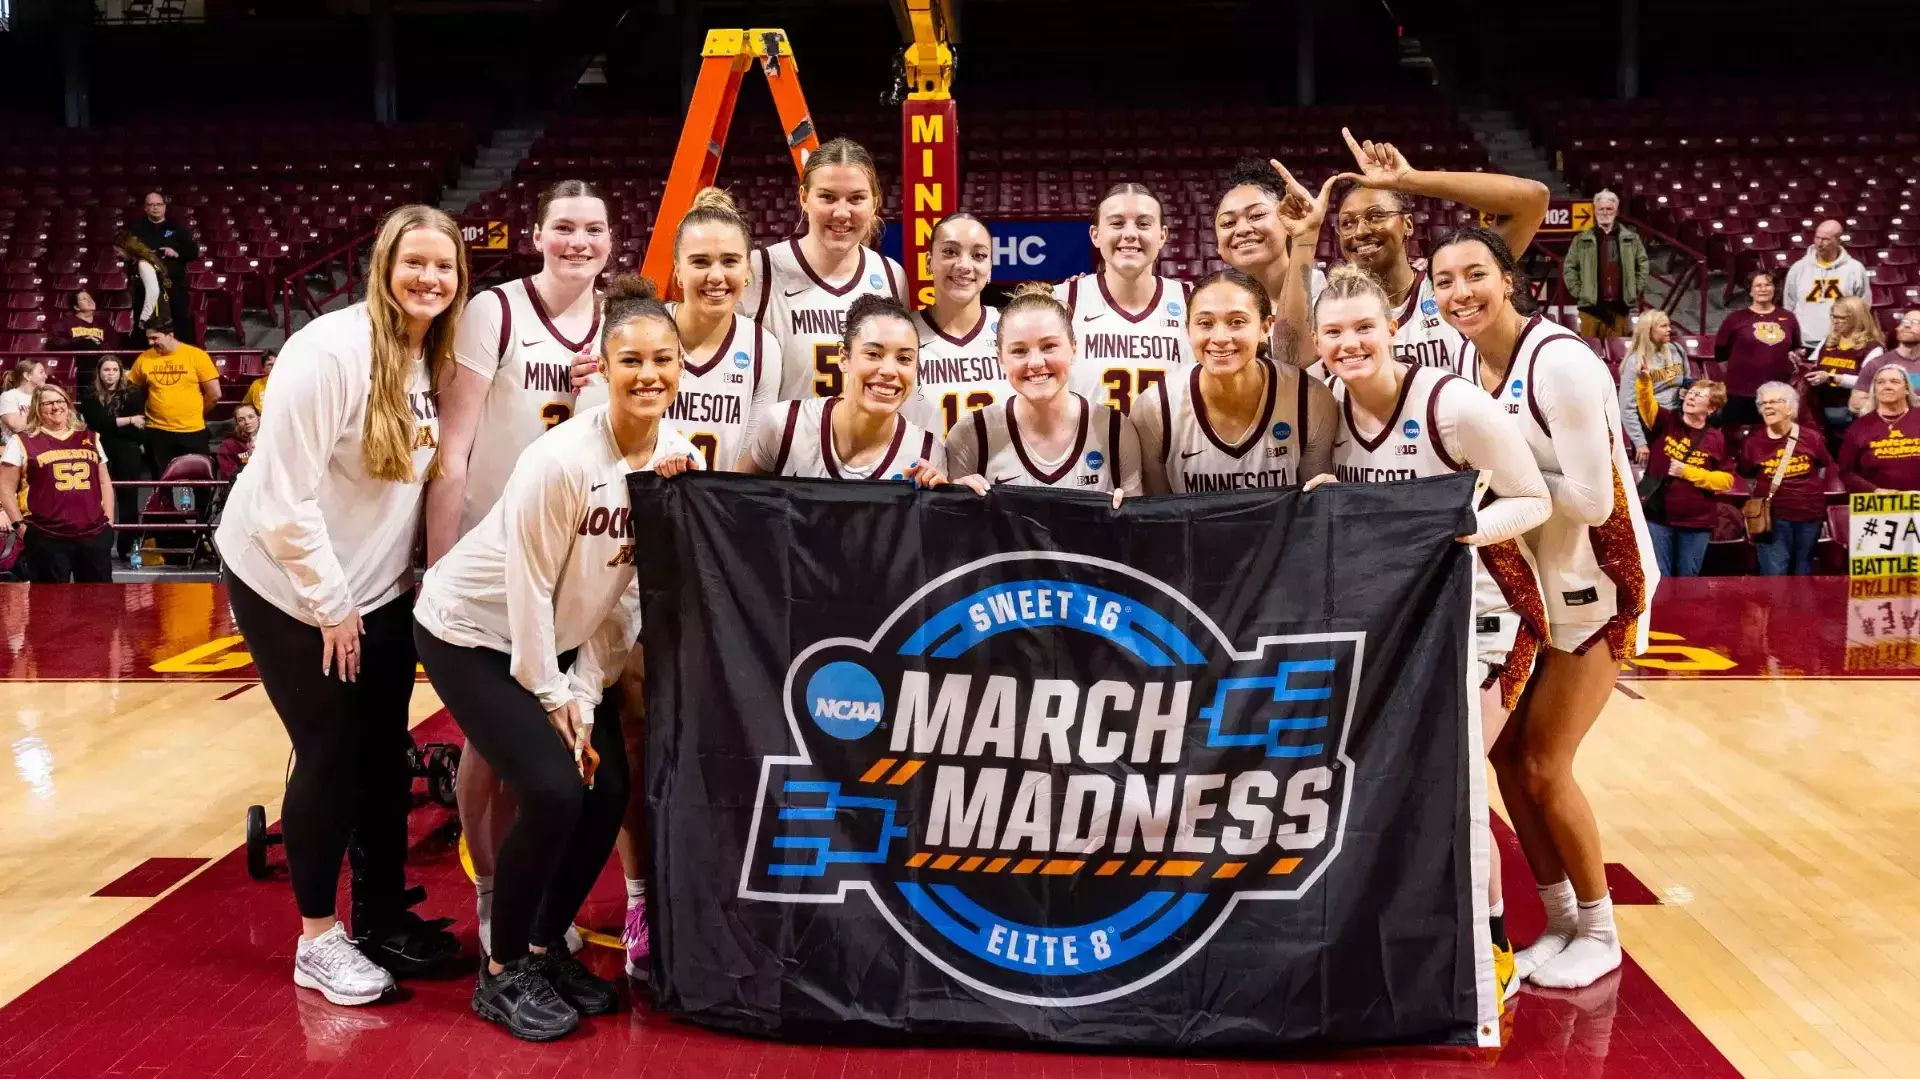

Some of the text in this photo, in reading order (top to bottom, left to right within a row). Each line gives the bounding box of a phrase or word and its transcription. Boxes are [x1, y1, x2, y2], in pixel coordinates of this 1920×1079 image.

[1545, 208, 1570, 225] 102
[461, 226, 485, 241] 101
[1084, 333, 1181, 363] MINNESOTA
[524, 361, 572, 394] MINN
[812, 343, 847, 398] 5
[917, 356, 1007, 387] MINNESOT
[53, 461, 91, 491] 52
[1853, 494, 1920, 512] BATTLE
[1863, 517, 1899, 551] #3
[1851, 556, 1918, 575] BATTLE
[968, 589, 1122, 632] SWEET 16
[815, 697, 881, 722] NCAA
[889, 670, 1193, 764] MARCH
[925, 765, 1333, 856] MADNESS
[986, 923, 1112, 966] ELITE 8
